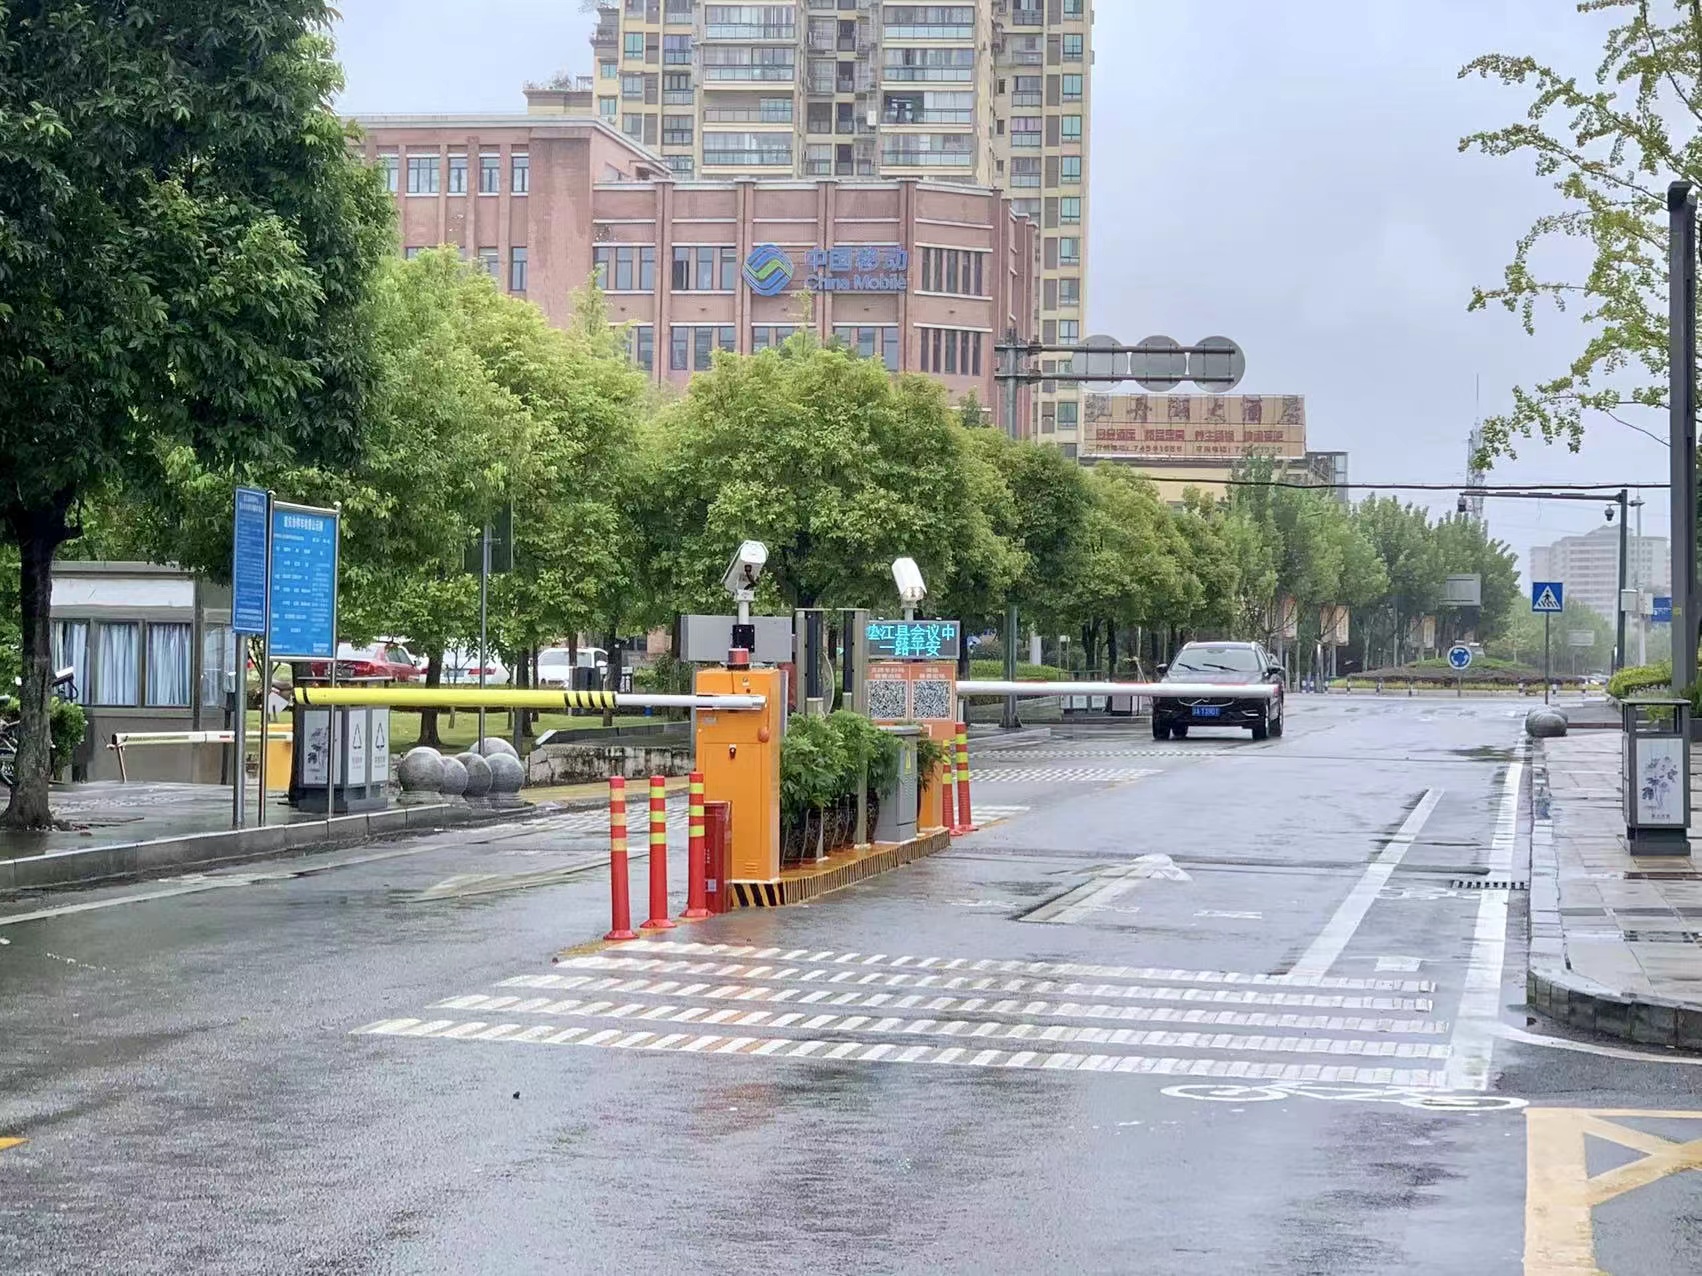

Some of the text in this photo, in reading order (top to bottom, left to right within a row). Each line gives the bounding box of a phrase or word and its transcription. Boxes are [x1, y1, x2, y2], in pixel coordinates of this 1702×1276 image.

[804, 246, 908, 271] 中国移动
[805, 274, 908, 290] China Mobile
[866, 624, 955, 640] 垫江县会议中
[879, 639, 942, 656] 一路平安
